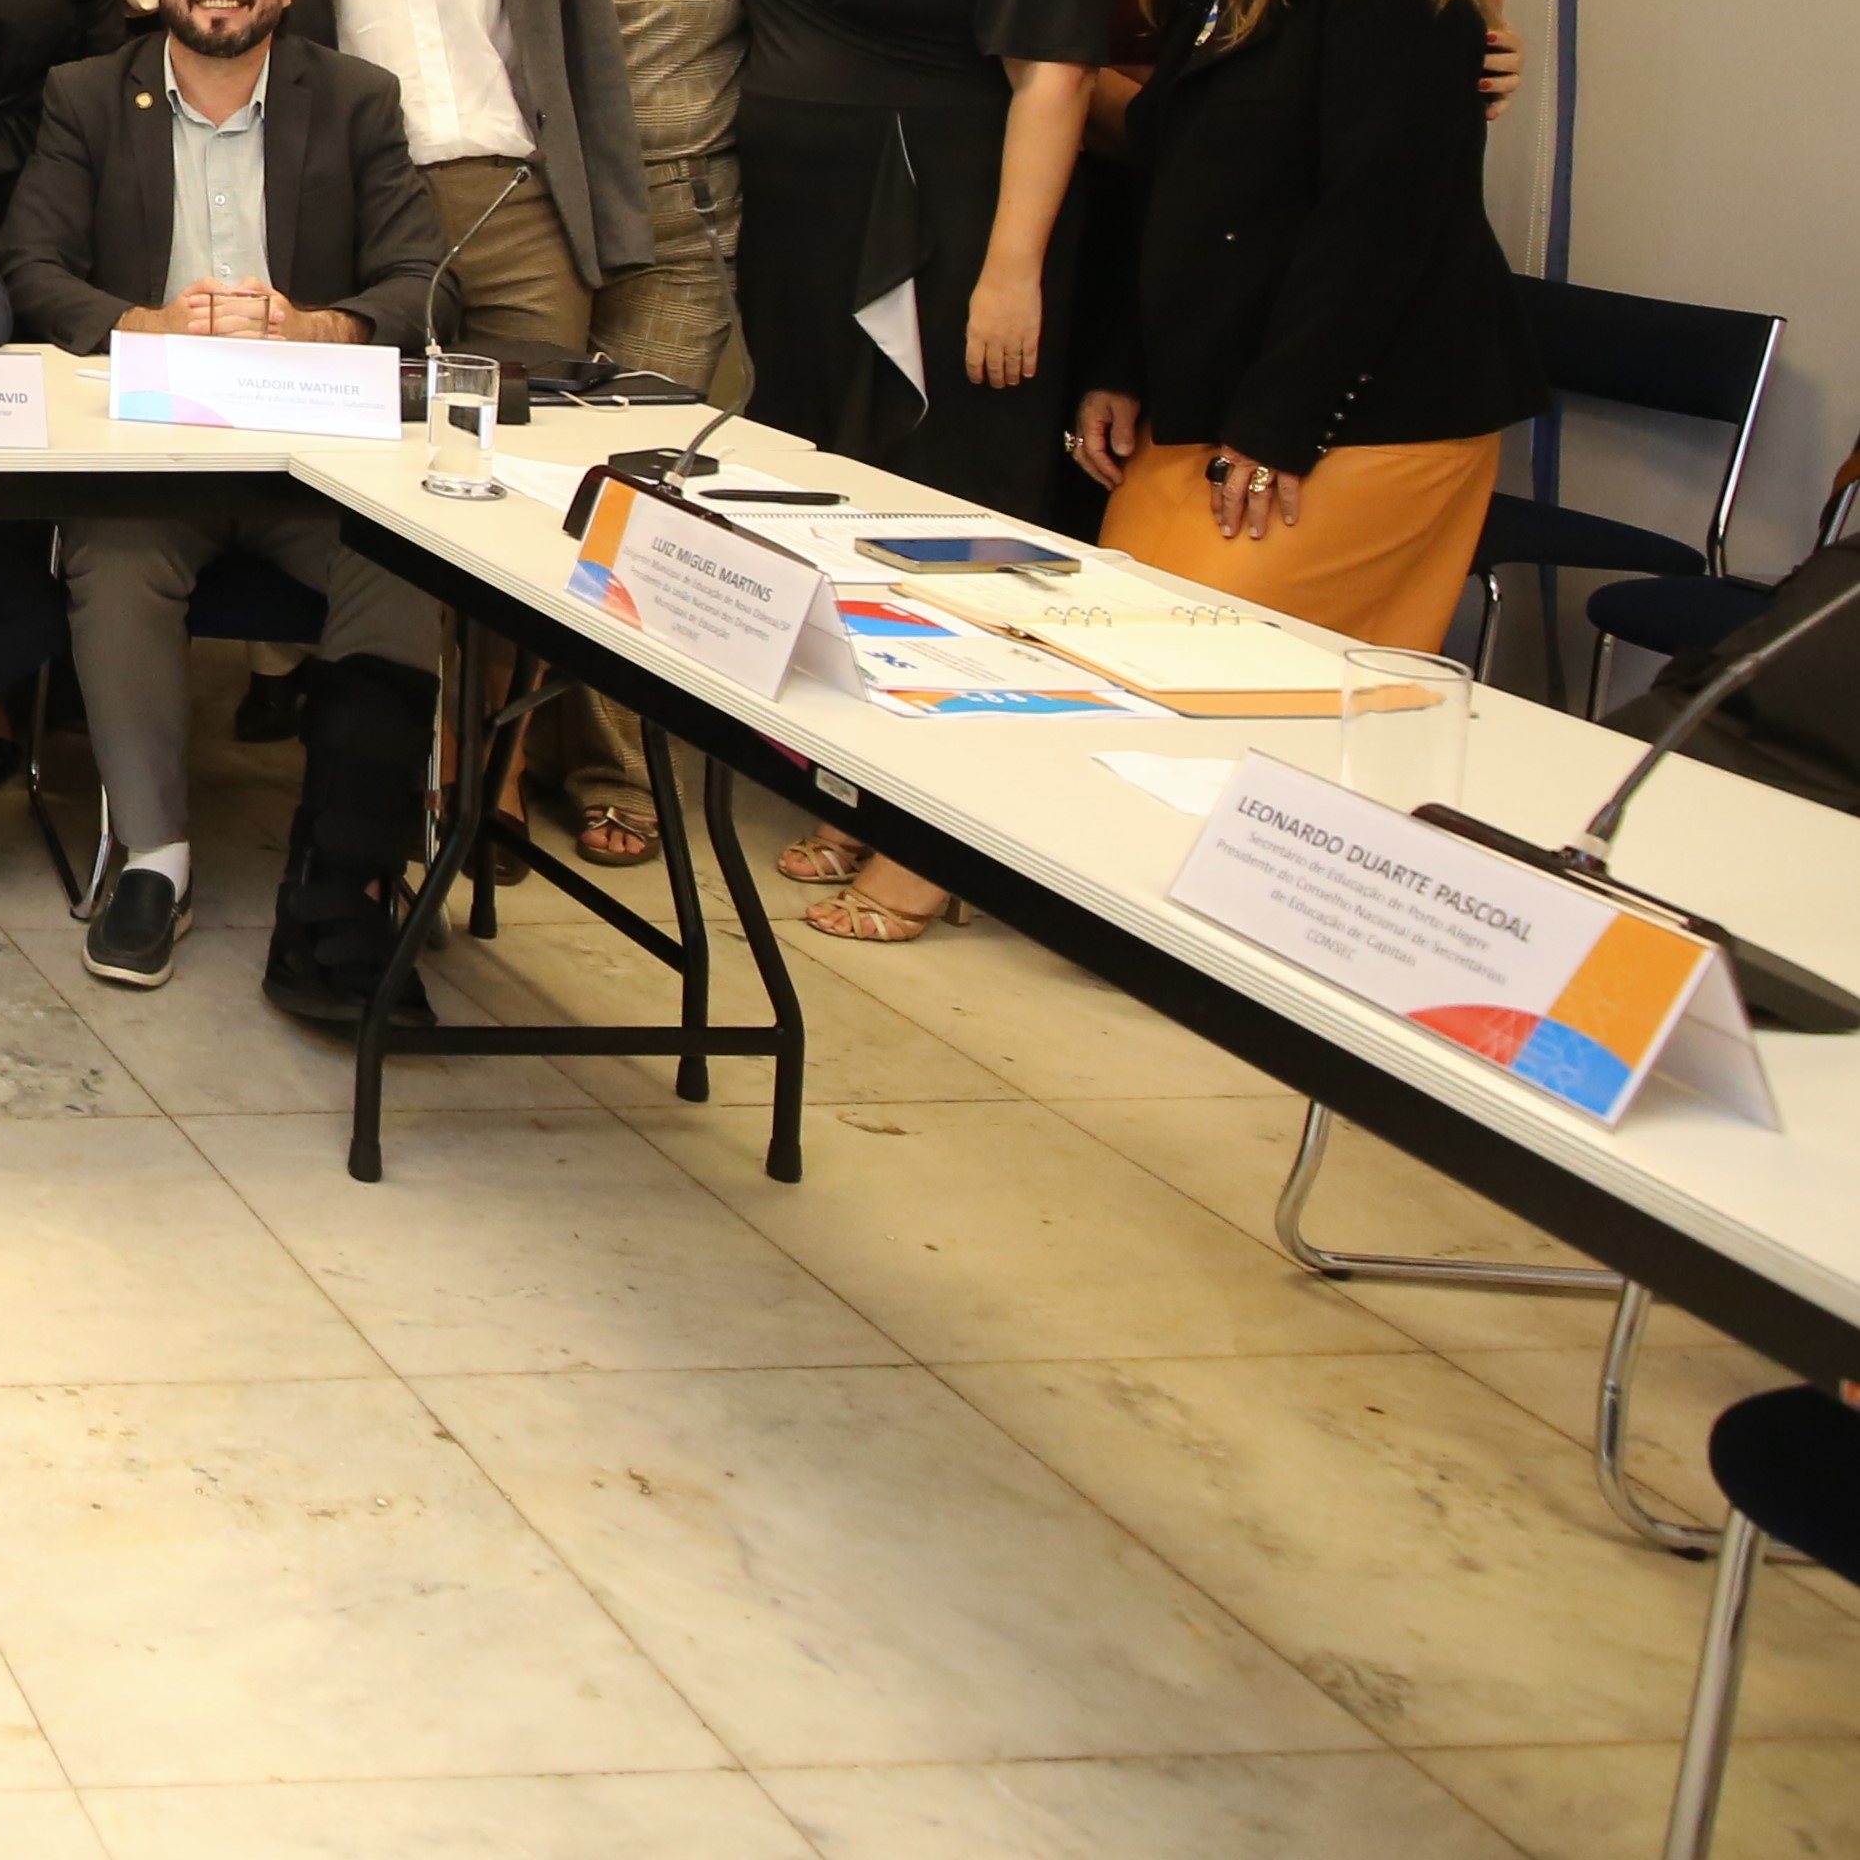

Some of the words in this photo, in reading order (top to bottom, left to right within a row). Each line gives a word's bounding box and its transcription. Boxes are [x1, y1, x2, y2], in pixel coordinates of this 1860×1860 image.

[237, 378, 294, 390] VALDOIR
[299, 382, 360, 396] WATHIER
[631, 566, 661, 588] Presidente
[662, 583, 670, 592] da
[691, 597, 719, 616] Nacional
[721, 612, 733, 622] dos
[734, 617, 769, 641] Dirigentes
[651, 537, 676, 557] LUIZ
[676, 548, 717, 577] MIGUEL
[719, 568, 772, 602] MARTINS
[682, 576, 691, 585] de
[692, 579, 723, 600] Educação
[723, 596, 733, 604] de
[688, 614, 697, 622] de
[697, 617, 730, 640] Educação
[1238, 797, 1344, 854] LEONARDO
[1346, 845, 1431, 894] DUARTE
[1434, 884, 1531, 942] PASCOAL
[1248, 832, 1307, 866] Secretário
[1308, 861, 1324, 873] de
[1326, 867, 1385, 902] Educação
[1387, 898, 1403, 910] de
[1408, 905, 1443, 929] Porto
[1445, 924, 1488, 950] Alegre
[1216, 838, 1275, 874] Presidente
[1276, 870, 1294, 883] do
[1296, 877, 1351, 910] Conselho
[1354, 904, 1409, 937] Nacional
[1411, 934, 1426, 946] de
[1432, 941, 1505, 984] Secretários
[1270, 890, 1286, 902] de
[1288, 896, 1345, 931] Educação
[1347, 928, 1362, 939] de
[1366, 934, 1415, 966] Capitais
[1306, 929, 1355, 959] CONSEC
